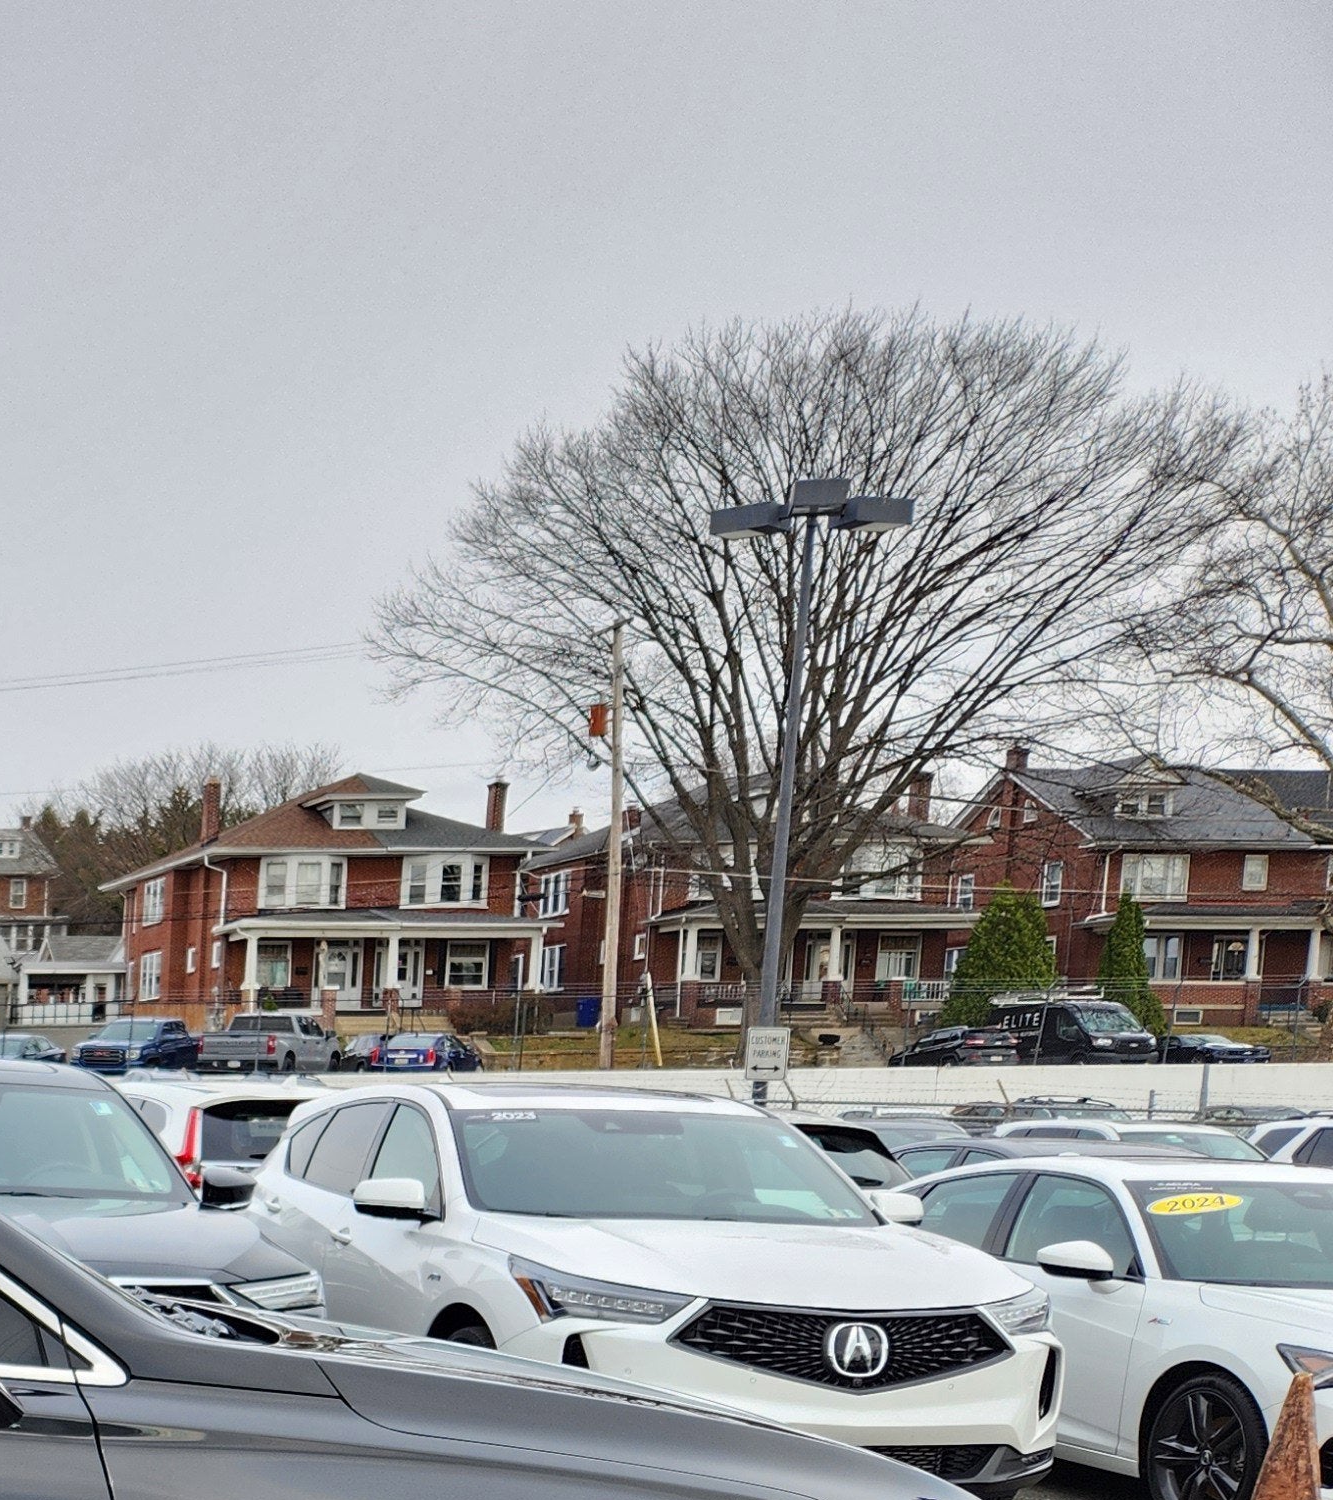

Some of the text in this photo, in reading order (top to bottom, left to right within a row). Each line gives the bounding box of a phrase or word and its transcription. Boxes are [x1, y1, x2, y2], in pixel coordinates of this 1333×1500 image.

[1002, 1012, 1041, 1029] ELITE
[751, 1035, 785, 1045] CUSTOMER
[753, 1049, 782, 1058] PARKING
[491, 1111, 537, 1121] 2023
[1166, 1195, 1226, 1212] 2024
